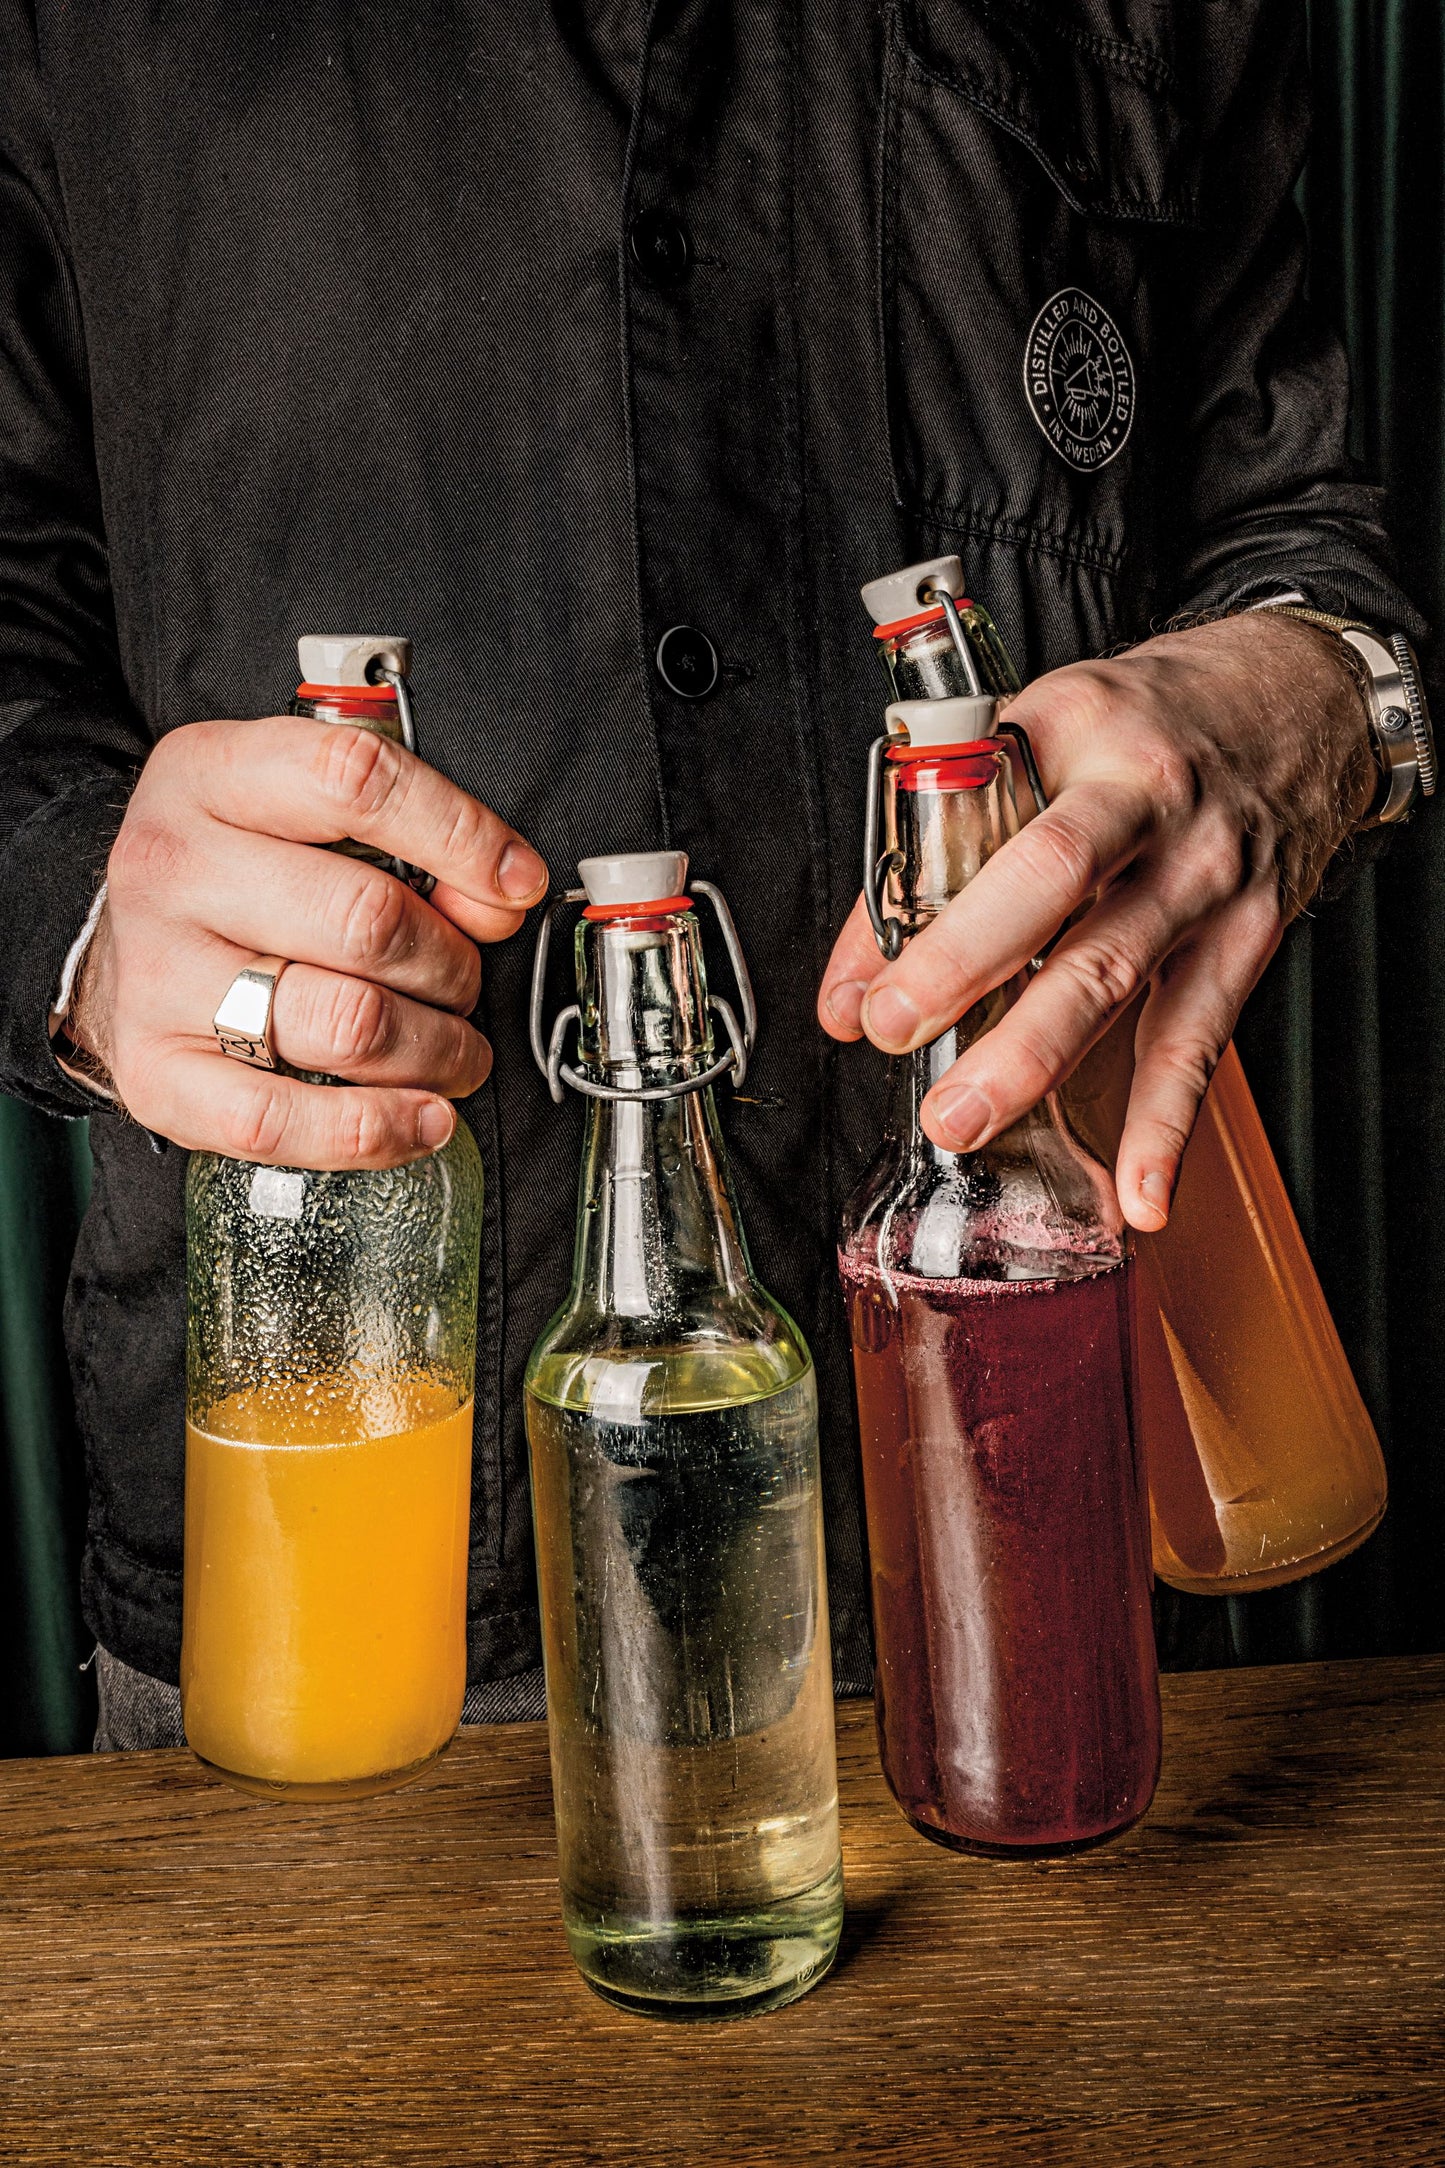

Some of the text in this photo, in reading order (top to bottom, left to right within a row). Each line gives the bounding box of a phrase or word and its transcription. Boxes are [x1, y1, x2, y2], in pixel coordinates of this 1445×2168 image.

[1032, 297, 1129, 421] DISTILLED AND BOTTLED
[1049, 417, 1112, 463] IN SWEDEN
